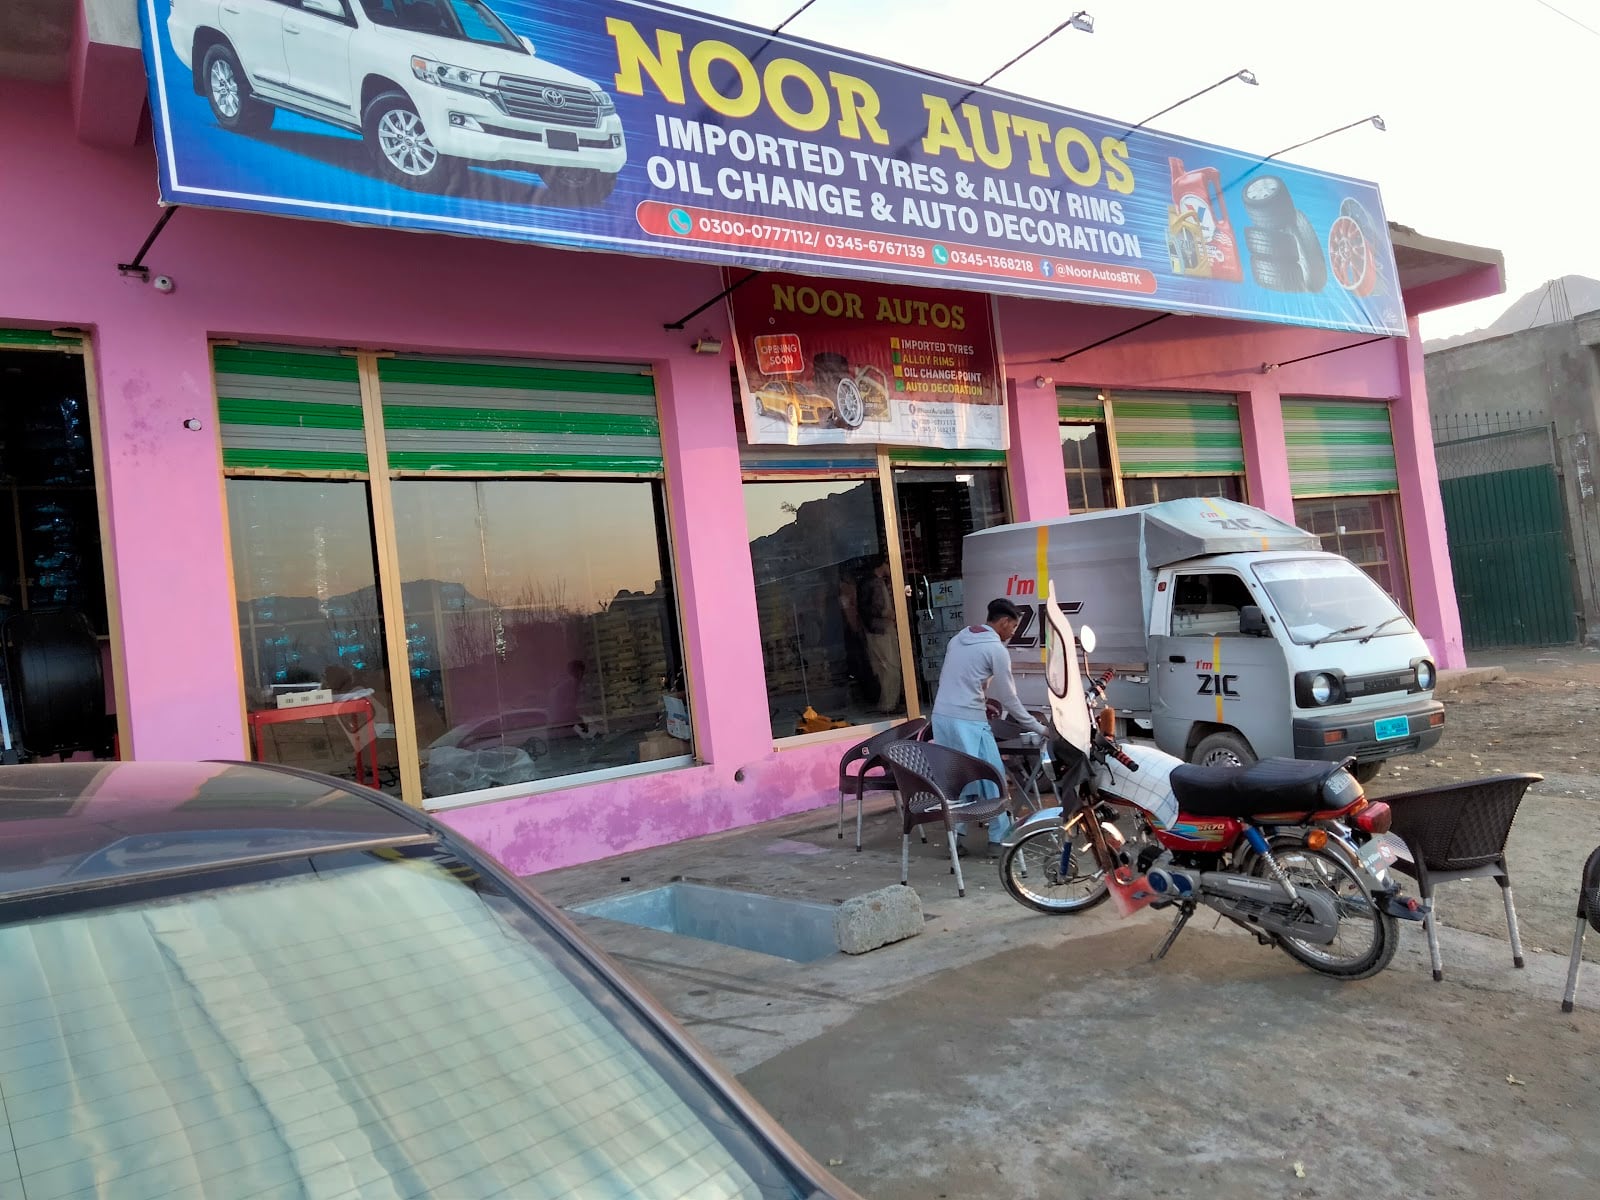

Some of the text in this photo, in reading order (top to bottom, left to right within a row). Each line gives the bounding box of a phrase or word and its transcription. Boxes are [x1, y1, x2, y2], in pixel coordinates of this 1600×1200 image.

[605, 17, 1136, 195] NOOR AUTOS
[655, 114, 1125, 226] IMPORTED TYRES & ALLOY RIMS
[647, 155, 1142, 259] OIL CHANGE & AUTO DECORATION
[699, 217, 1142, 285] 0300-0777112/ 0345-6767139 0345-1368218 @NoorAutosBTK
[771, 283, 966, 330] NOOR AUTOS
[761, 344, 797, 354] OPENING
[901, 339, 974, 355] IMPORTED TYRES
[769, 355, 793, 365] SOON
[903, 354, 955, 367] ALLOY RIMS
[904, 367, 982, 382] OIL CHANGE POINT
[906, 382, 982, 396] AUTO DECORATION
[1208, 518, 1266, 531] ZIC
[939, 584, 953, 594] ZIC
[1006, 574, 1035, 596] I'm
[1196, 659, 1213, 670] I'm
[1196, 673, 1240, 697] ZIC
